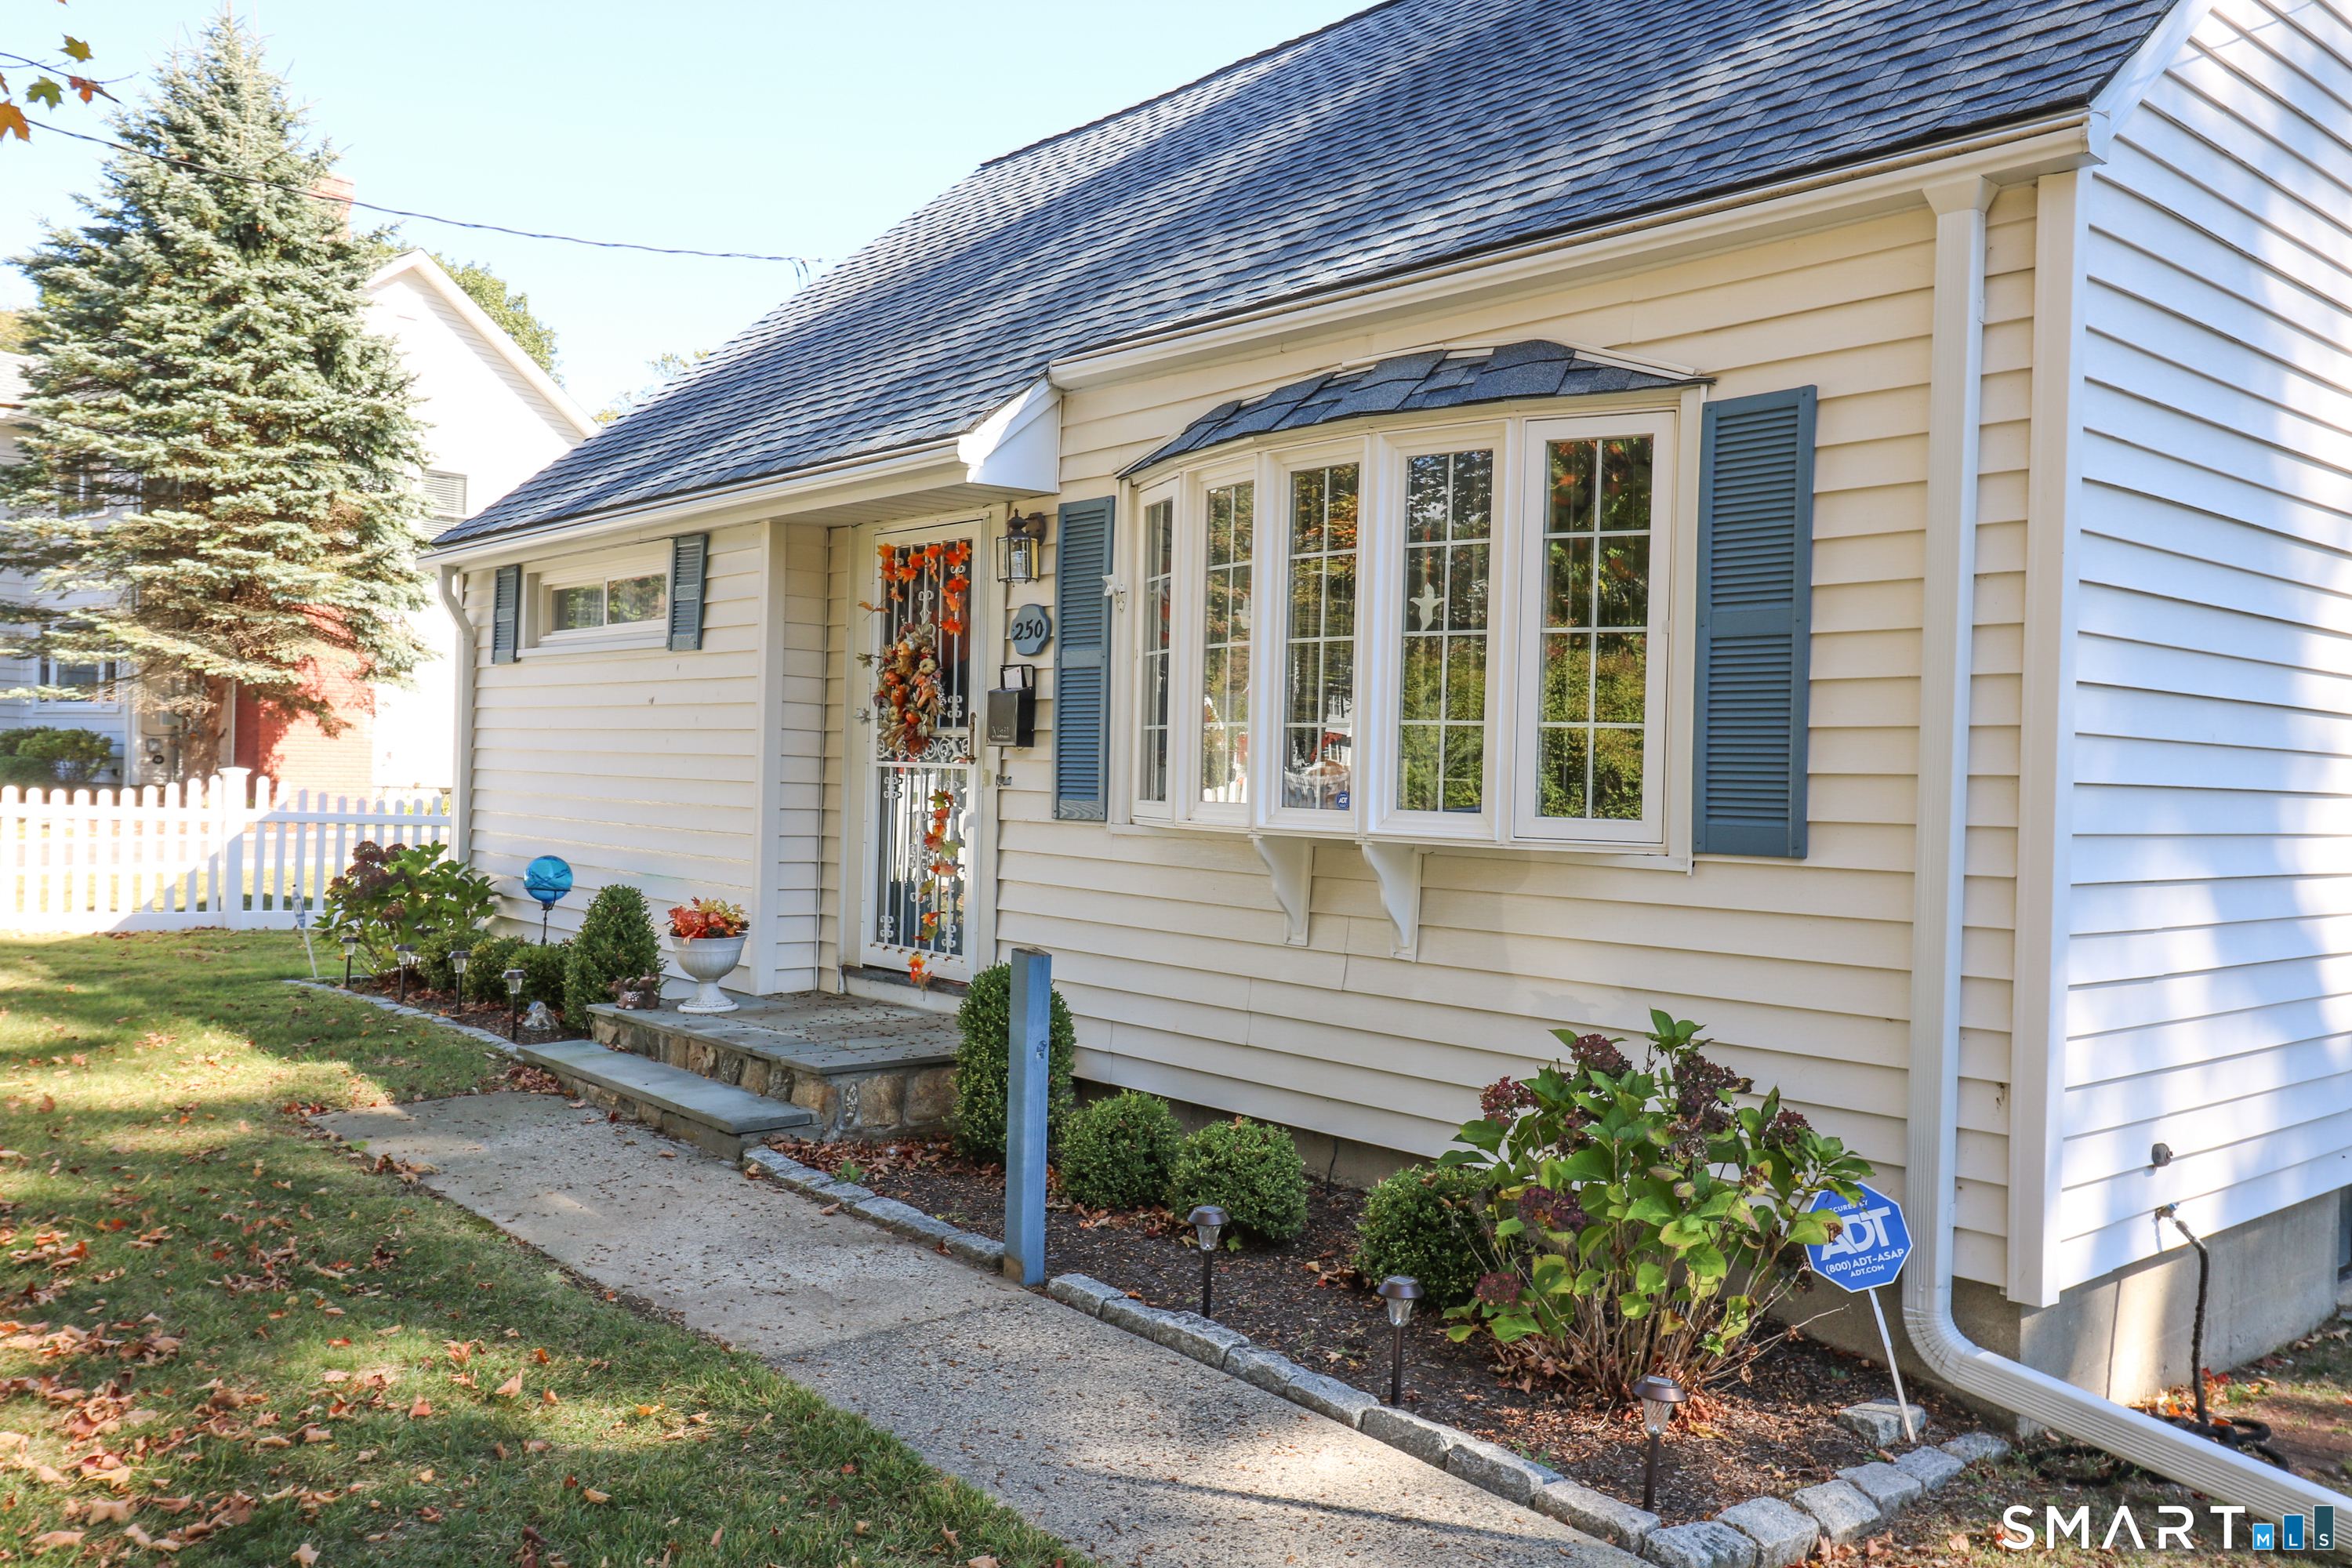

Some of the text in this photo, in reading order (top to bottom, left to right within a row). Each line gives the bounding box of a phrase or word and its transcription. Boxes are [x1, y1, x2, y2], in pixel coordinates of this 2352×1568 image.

[1012, 619, 1044, 641] 250
[992, 726, 1010, 738] Mail
[1820, 1206, 1891, 1261] ADT
[1825, 1248, 1905, 1276] (800) ADT-ASAP
[1850, 1264, 1886, 1278] ADT.COM
